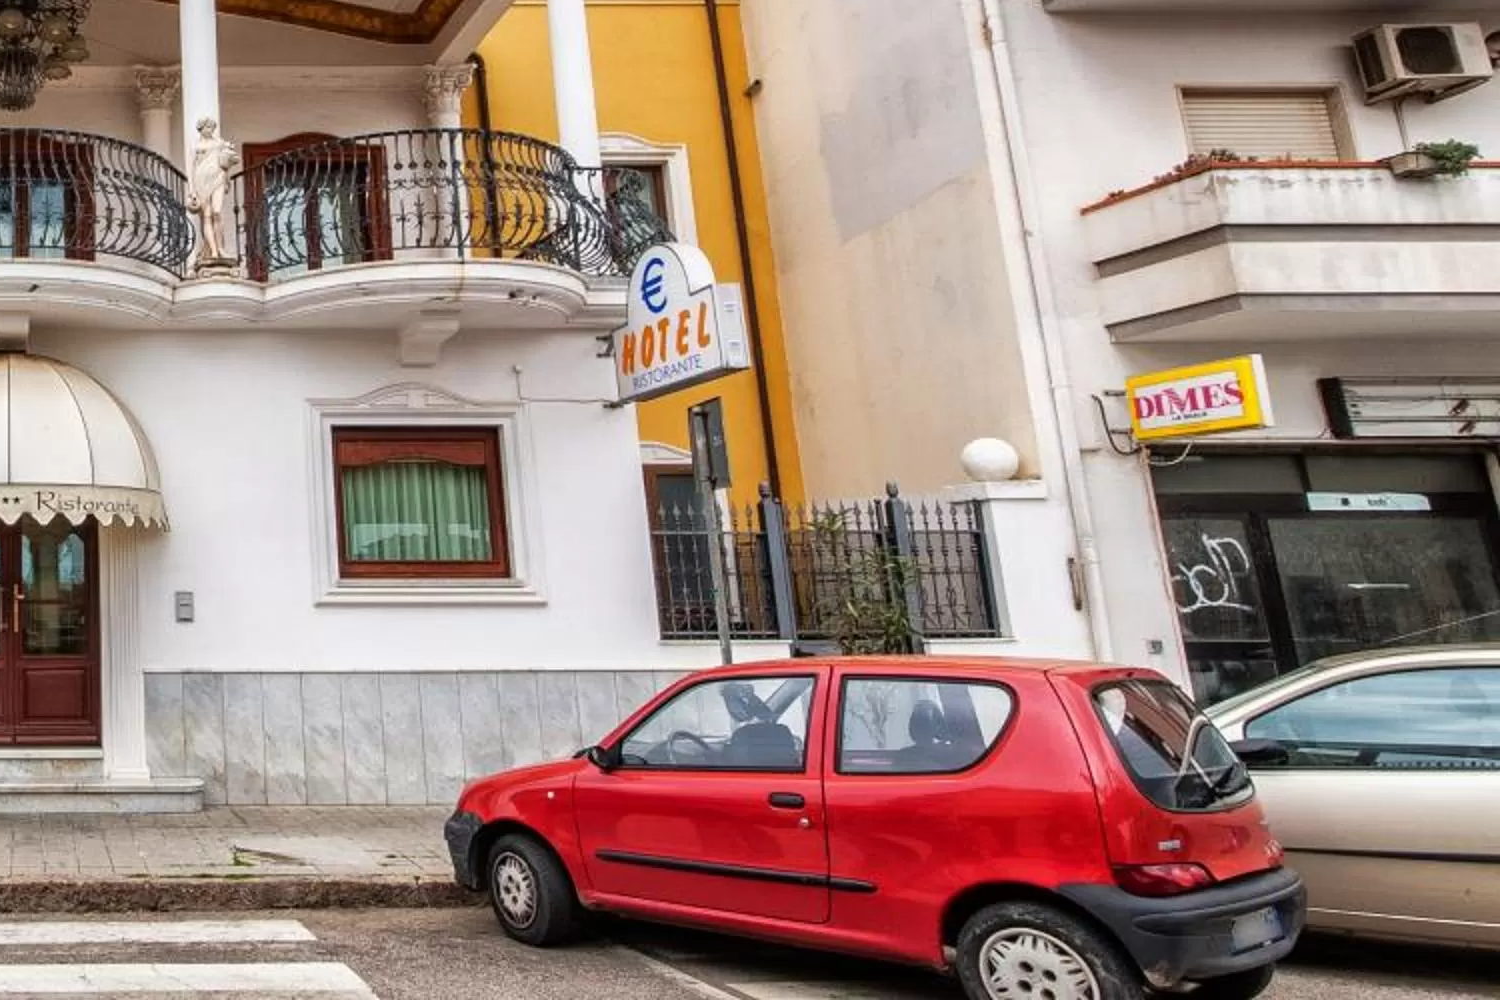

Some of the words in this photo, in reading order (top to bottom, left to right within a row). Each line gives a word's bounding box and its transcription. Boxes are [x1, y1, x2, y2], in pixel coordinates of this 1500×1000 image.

[621, 300, 711, 377] HOTEL
[632, 353, 704, 390] RISTORANTE
[1133, 380, 1245, 420] DIMES
[32, 490, 141, 515] Ristorante
